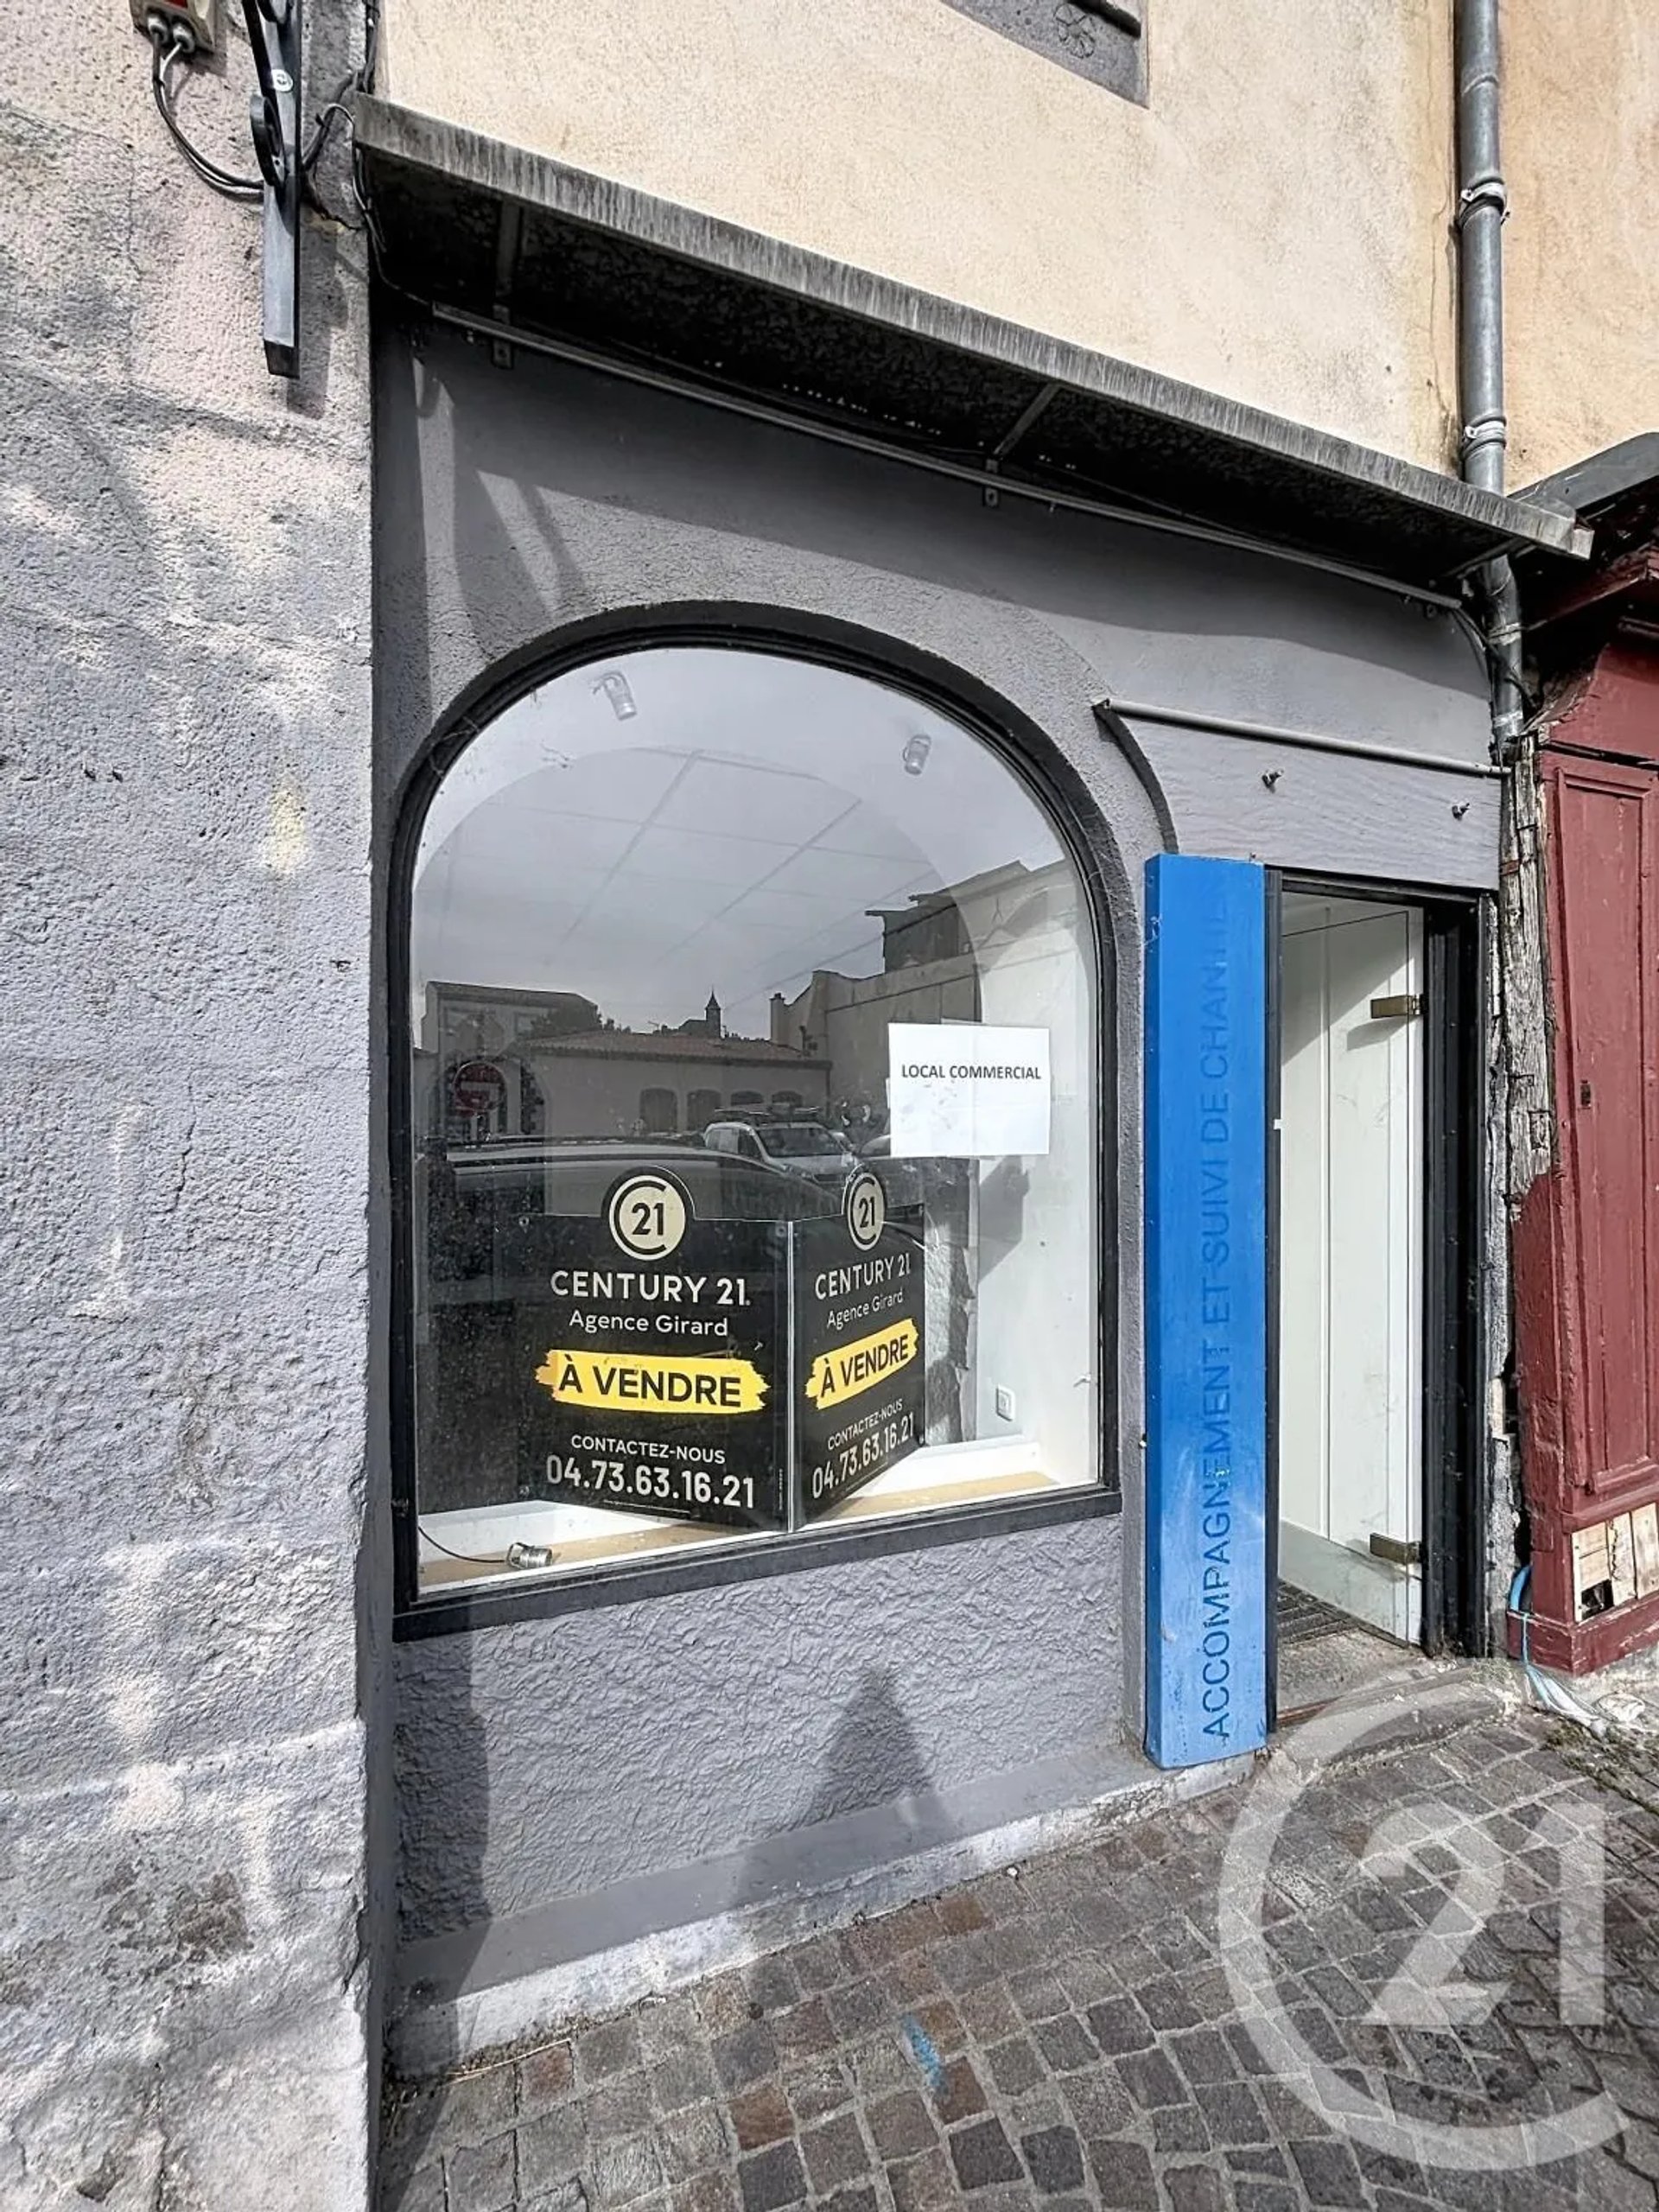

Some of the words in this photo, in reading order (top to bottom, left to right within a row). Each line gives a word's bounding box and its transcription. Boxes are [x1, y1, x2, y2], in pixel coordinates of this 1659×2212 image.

[901, 1064, 945, 1078] LOCAL
[949, 1065, 1042, 1080] COMMERCIAL
[1200, 1093, 1229, 1141] DE
[632, 1202, 664, 1236] 21
[858, 1196, 876, 1229] 21
[1201, 1160, 1230, 1267] SUIVI
[550, 1270, 707, 1303] CENTURY
[815, 1255, 894, 1300] CENTURY
[1201, 1277, 1230, 1324] ET
[569, 1309, 650, 1333] Agence
[655, 1314, 728, 1337] Girard
[826, 1301, 869, 1331] Agence
[872, 1287, 904, 1313] Girard
[558, 1354, 583, 1394] À
[593, 1366, 741, 1408] VENDRE
[820, 1357, 836, 1399] À
[840, 1333, 909, 1387] VENDRE
[828, 1398, 904, 1451] CONTACTEZ-NOUS
[570, 1434, 726, 1465] CONTACTEZ-NOUS
[812, 1412, 915, 1499] 04.73.63.16.21
[545, 1454, 754, 1509] 04.73.63.16.21
[1202, 1338, 1230, 1738] ACCOMPAGNEMENT
